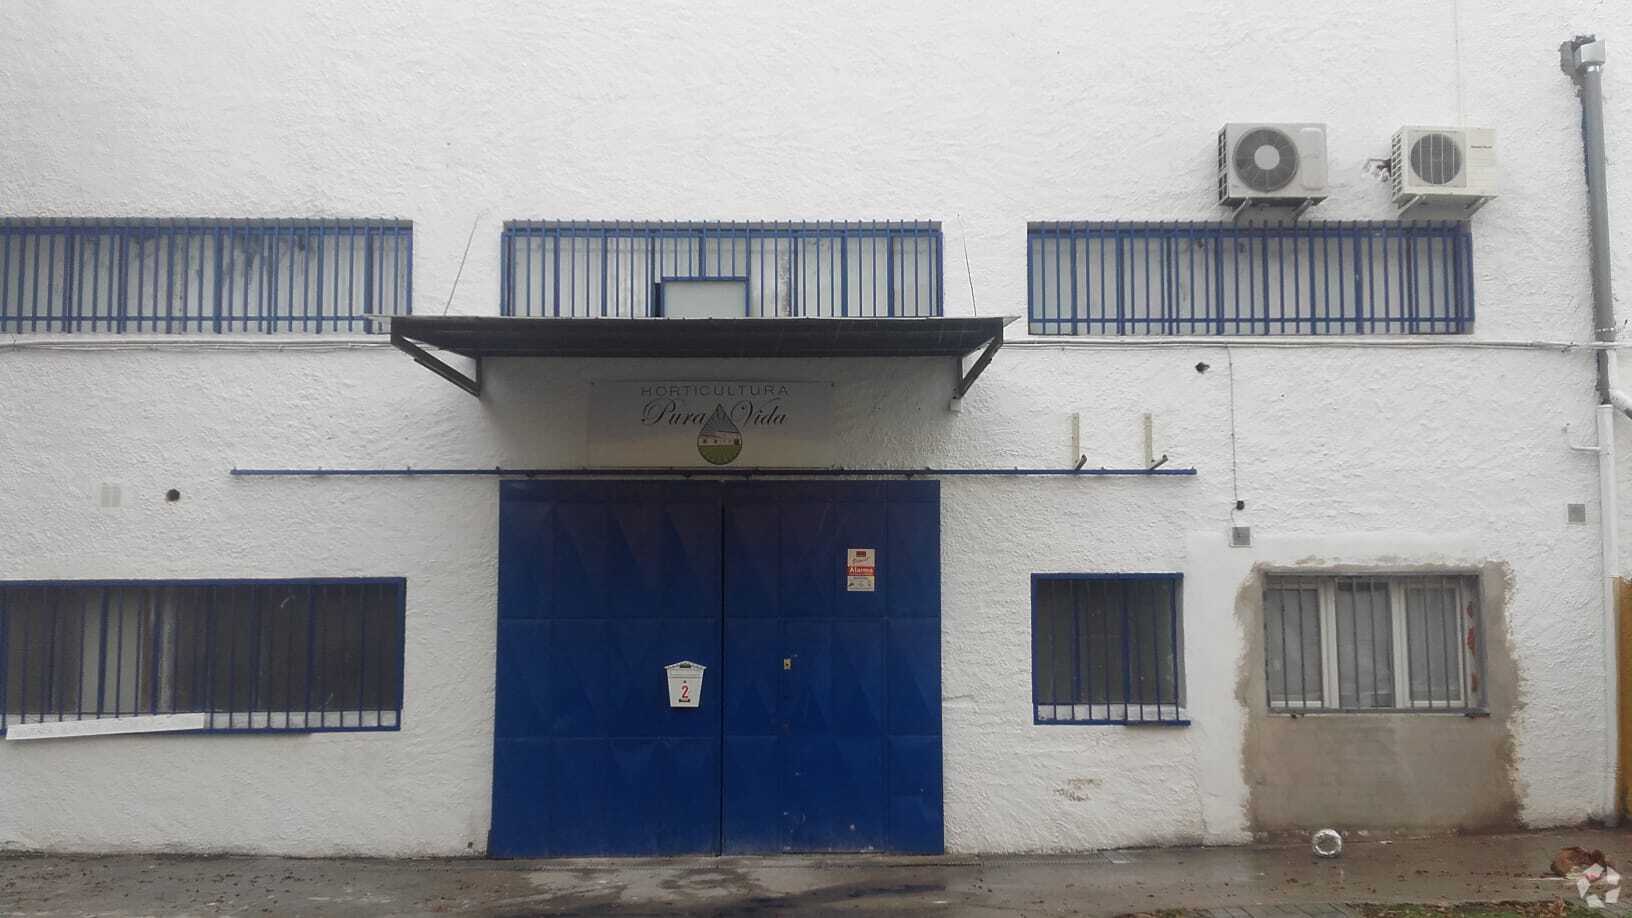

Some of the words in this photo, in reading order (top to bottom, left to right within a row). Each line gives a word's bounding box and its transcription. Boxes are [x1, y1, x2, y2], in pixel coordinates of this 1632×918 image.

[641, 384, 789, 397] HORTICULTURA
[641, 398, 706, 427] Pura
[730, 398, 788, 429] Vida
[681, 684, 689, 699] 2
